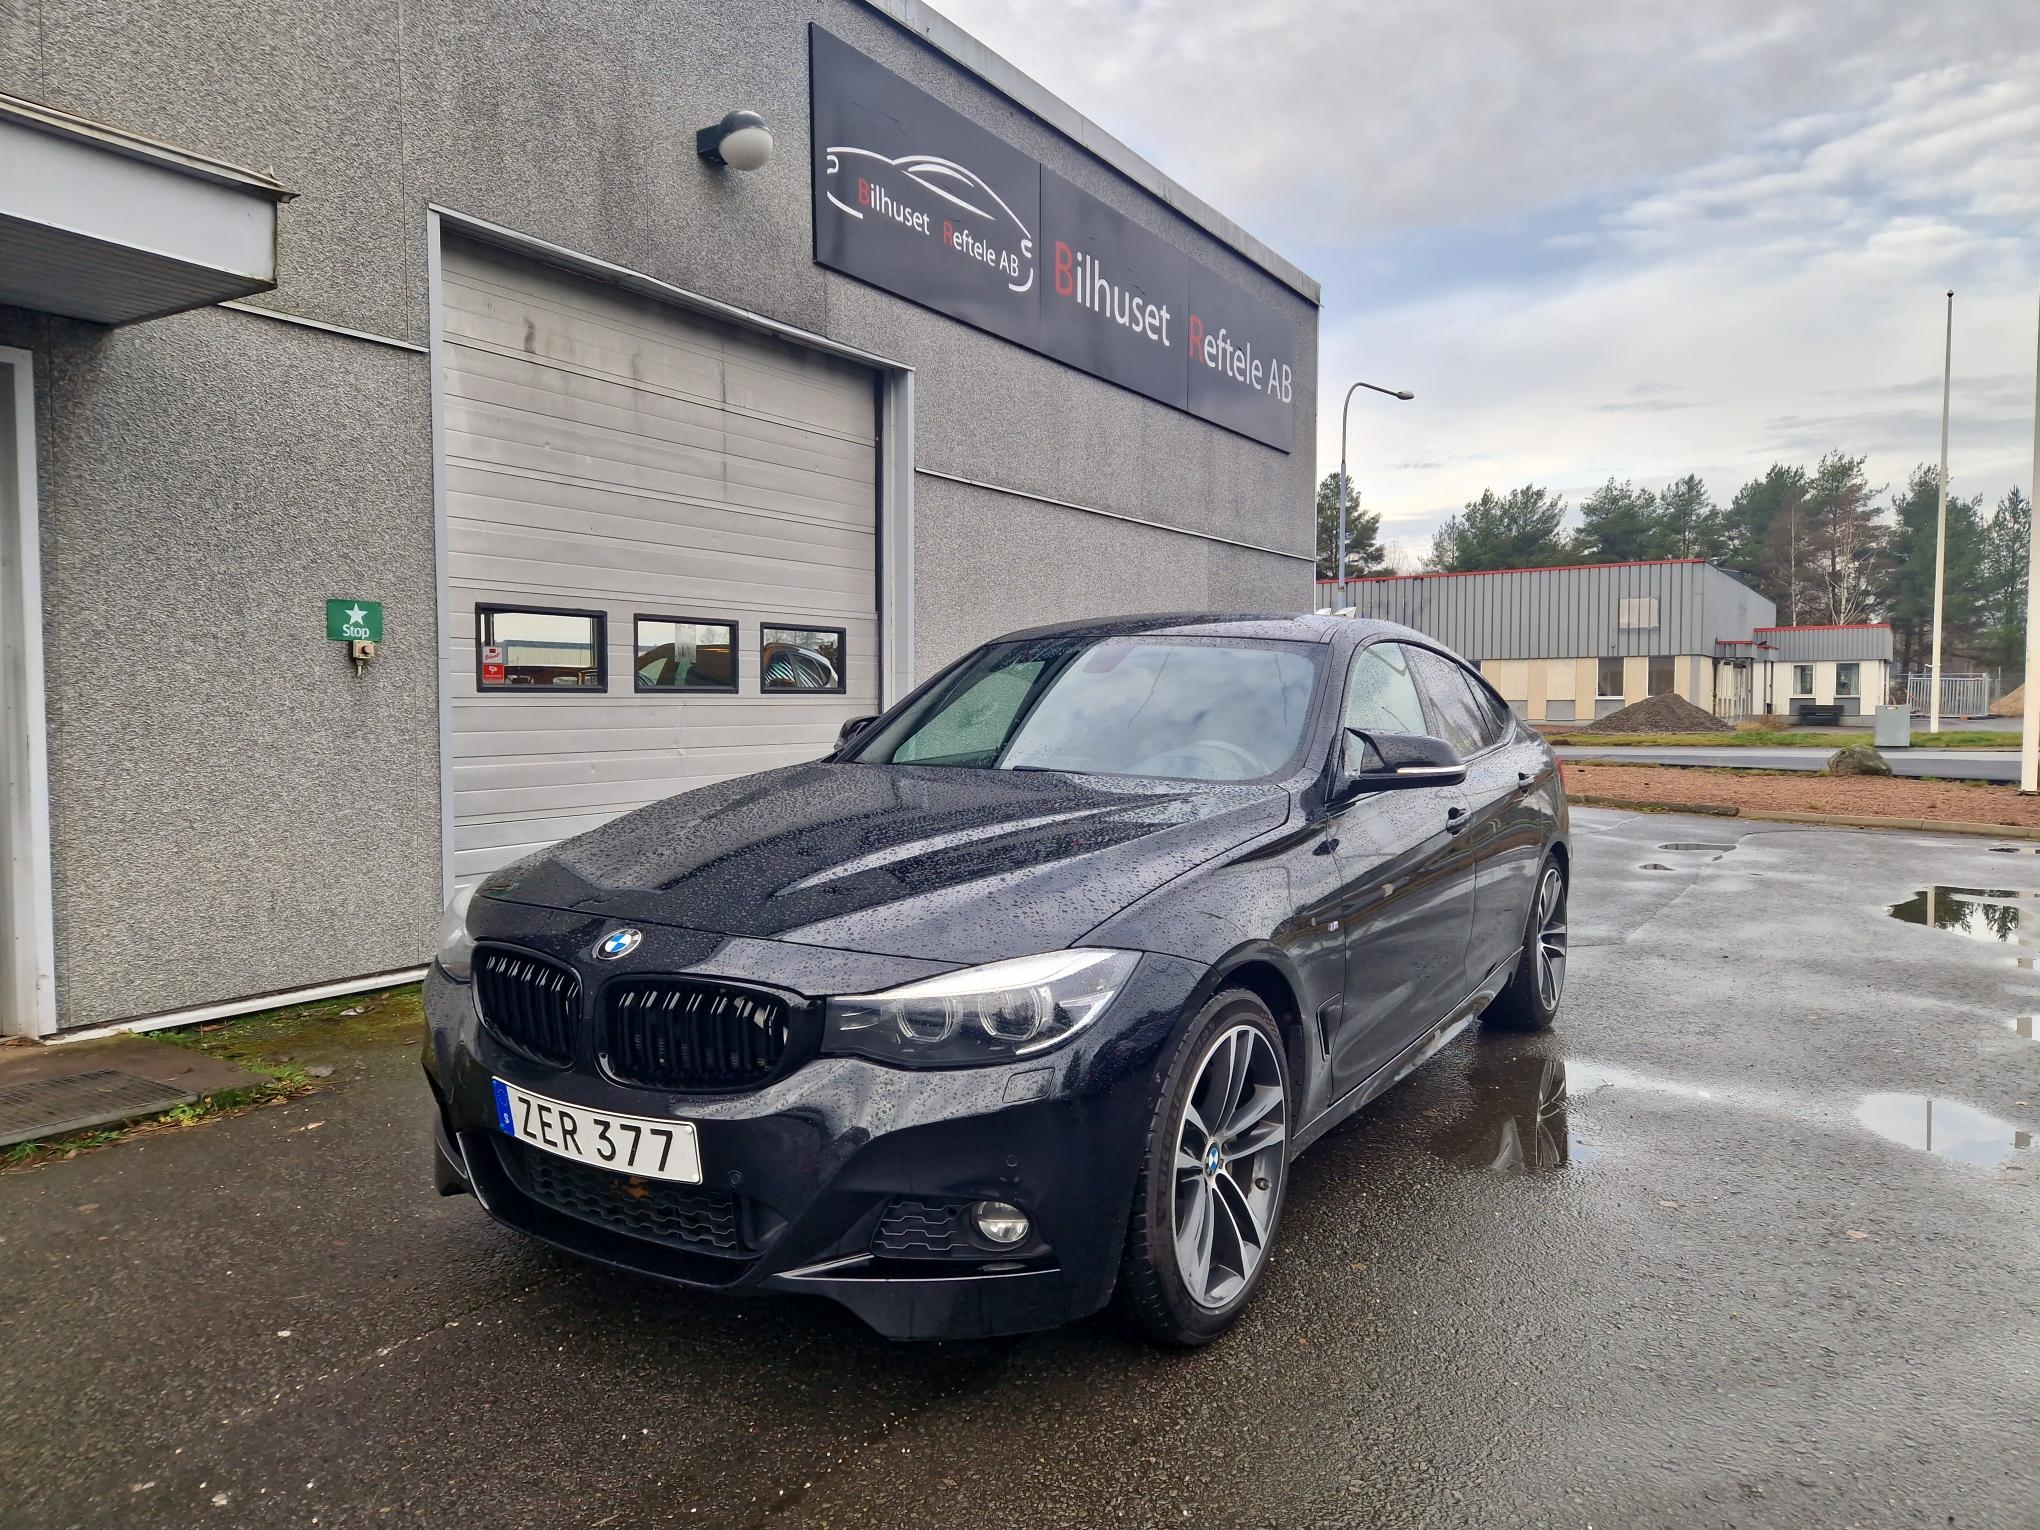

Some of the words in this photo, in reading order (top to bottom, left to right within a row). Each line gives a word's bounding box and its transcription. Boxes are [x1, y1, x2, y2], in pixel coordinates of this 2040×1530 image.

[857, 177, 930, 236] Bilhuset
[943, 219, 996, 267] Reftele
[999, 250, 1019, 277] AB
[1055, 240, 1171, 347] Bilhuset
[1189, 313, 1263, 390] Reftele
[1267, 358, 1292, 403] AB
[342, 623, 370, 640] Stop
[503, 1112, 510, 1124] S
[517, 1095, 583, 1156] ZER
[593, 1118, 674, 1172] 377
